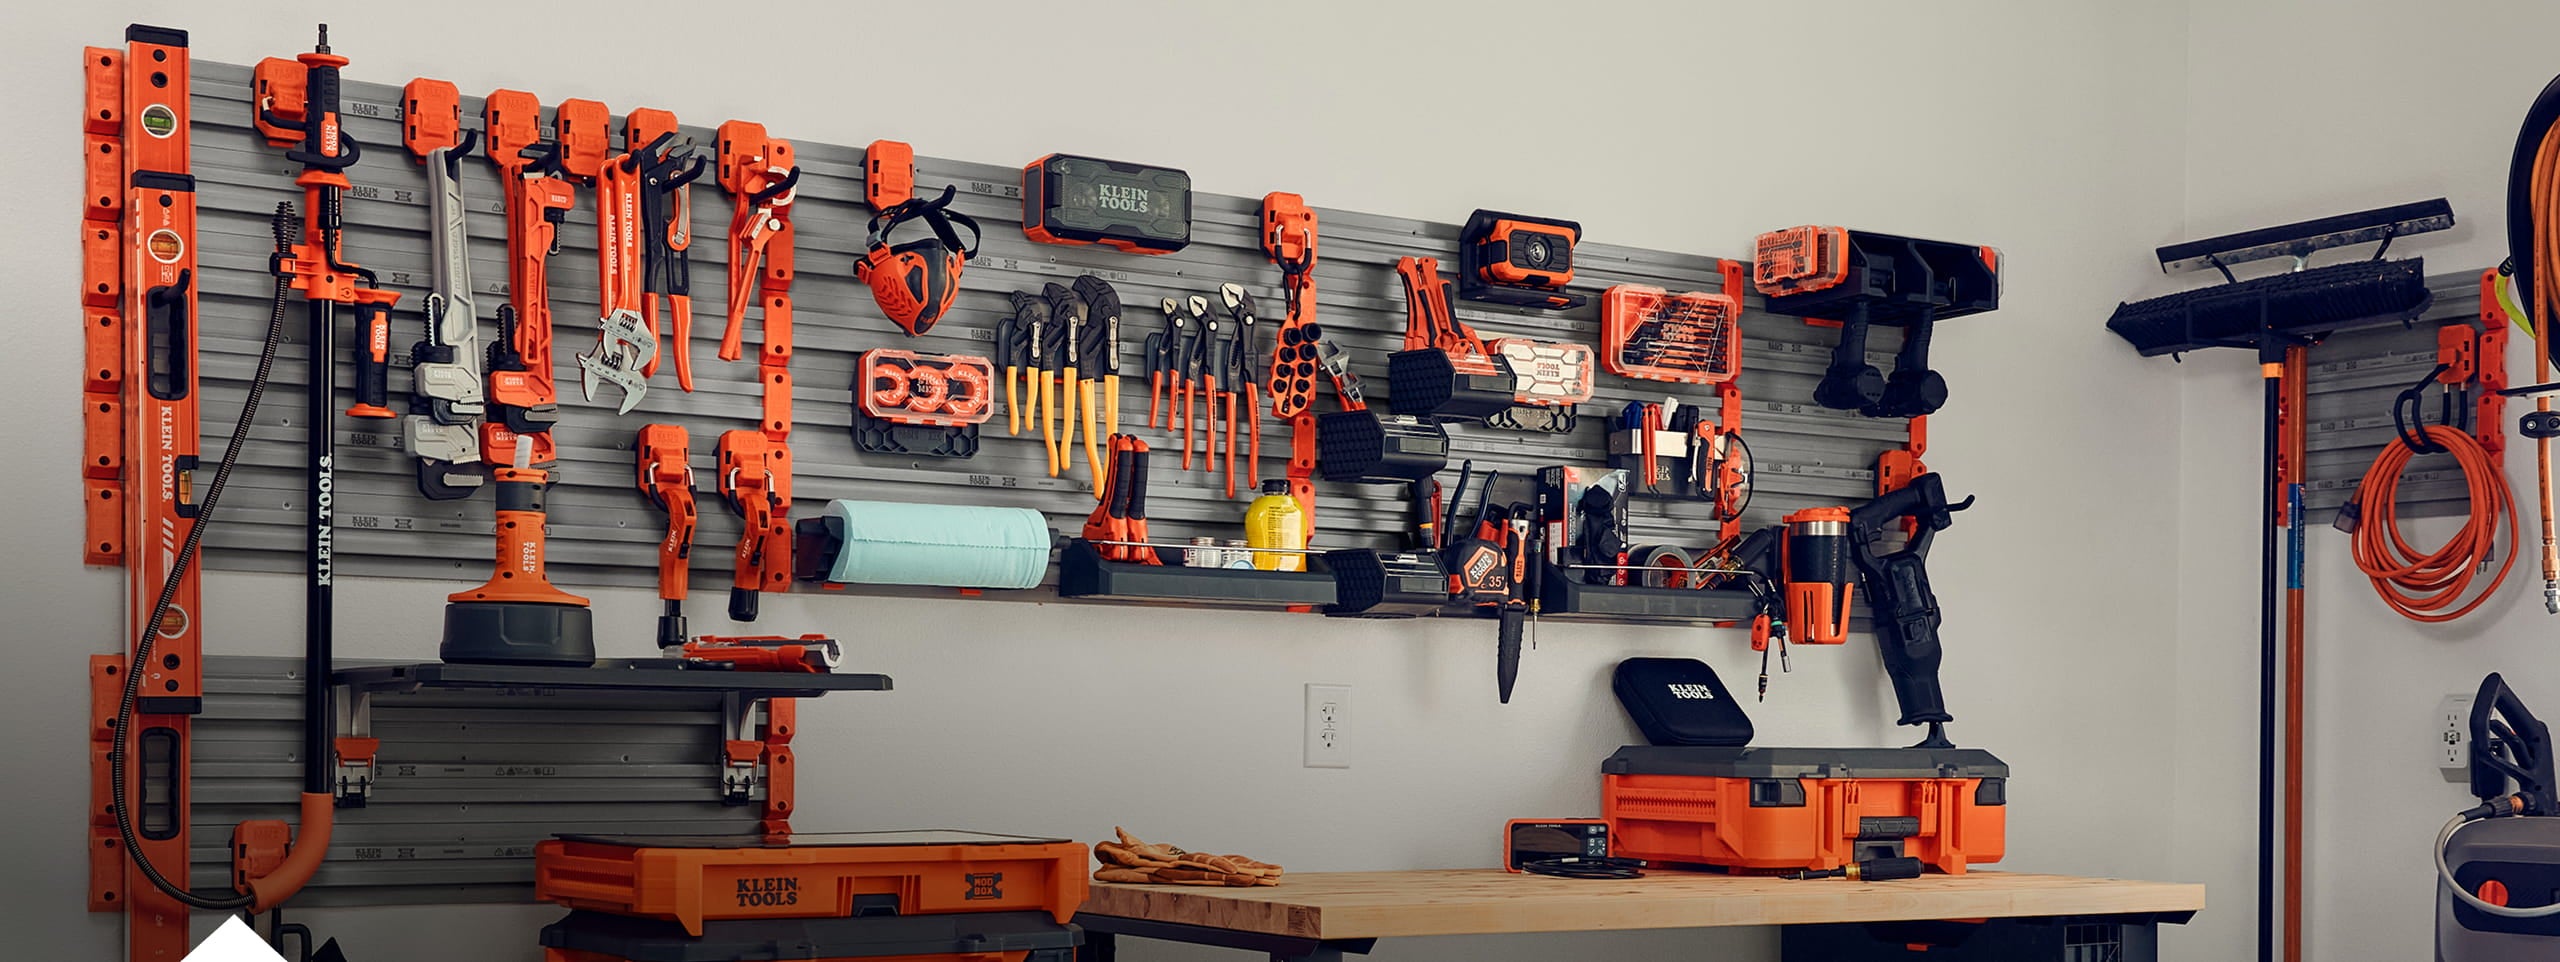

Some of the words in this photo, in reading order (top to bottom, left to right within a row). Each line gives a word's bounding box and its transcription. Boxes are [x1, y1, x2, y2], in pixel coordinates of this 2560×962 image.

[1099, 184, 1148, 201] KLEIN
[625, 193, 633, 219] KLEIN
[1099, 197, 1148, 213] TOOLS
[625, 220, 633, 248] TOOLS
[610, 242, 618, 275] TOOLS
[1536, 370, 1560, 378] KLEIN
[1537, 362, 1560, 370] TOOLS
[958, 370, 980, 385] KLEIN
[967, 386, 981, 408] TOOLS
[161, 406, 173, 450] KLEIN
[162, 454, 173, 500] TOOLS
[318, 455, 332, 519] TOOLS
[318, 525, 331, 587] KLEIN
[1469, 552, 1489, 577] KLEIN
[1474, 559, 1493, 580] TOOLS
[1668, 684, 1709, 692] KLEIN
[1673, 691, 1714, 699] TOOLS
[737, 877, 798, 893] KLEIN
[974, 878, 993, 886] MOD
[974, 886, 993, 895] BOX
[736, 891, 798, 907] TOOLS
